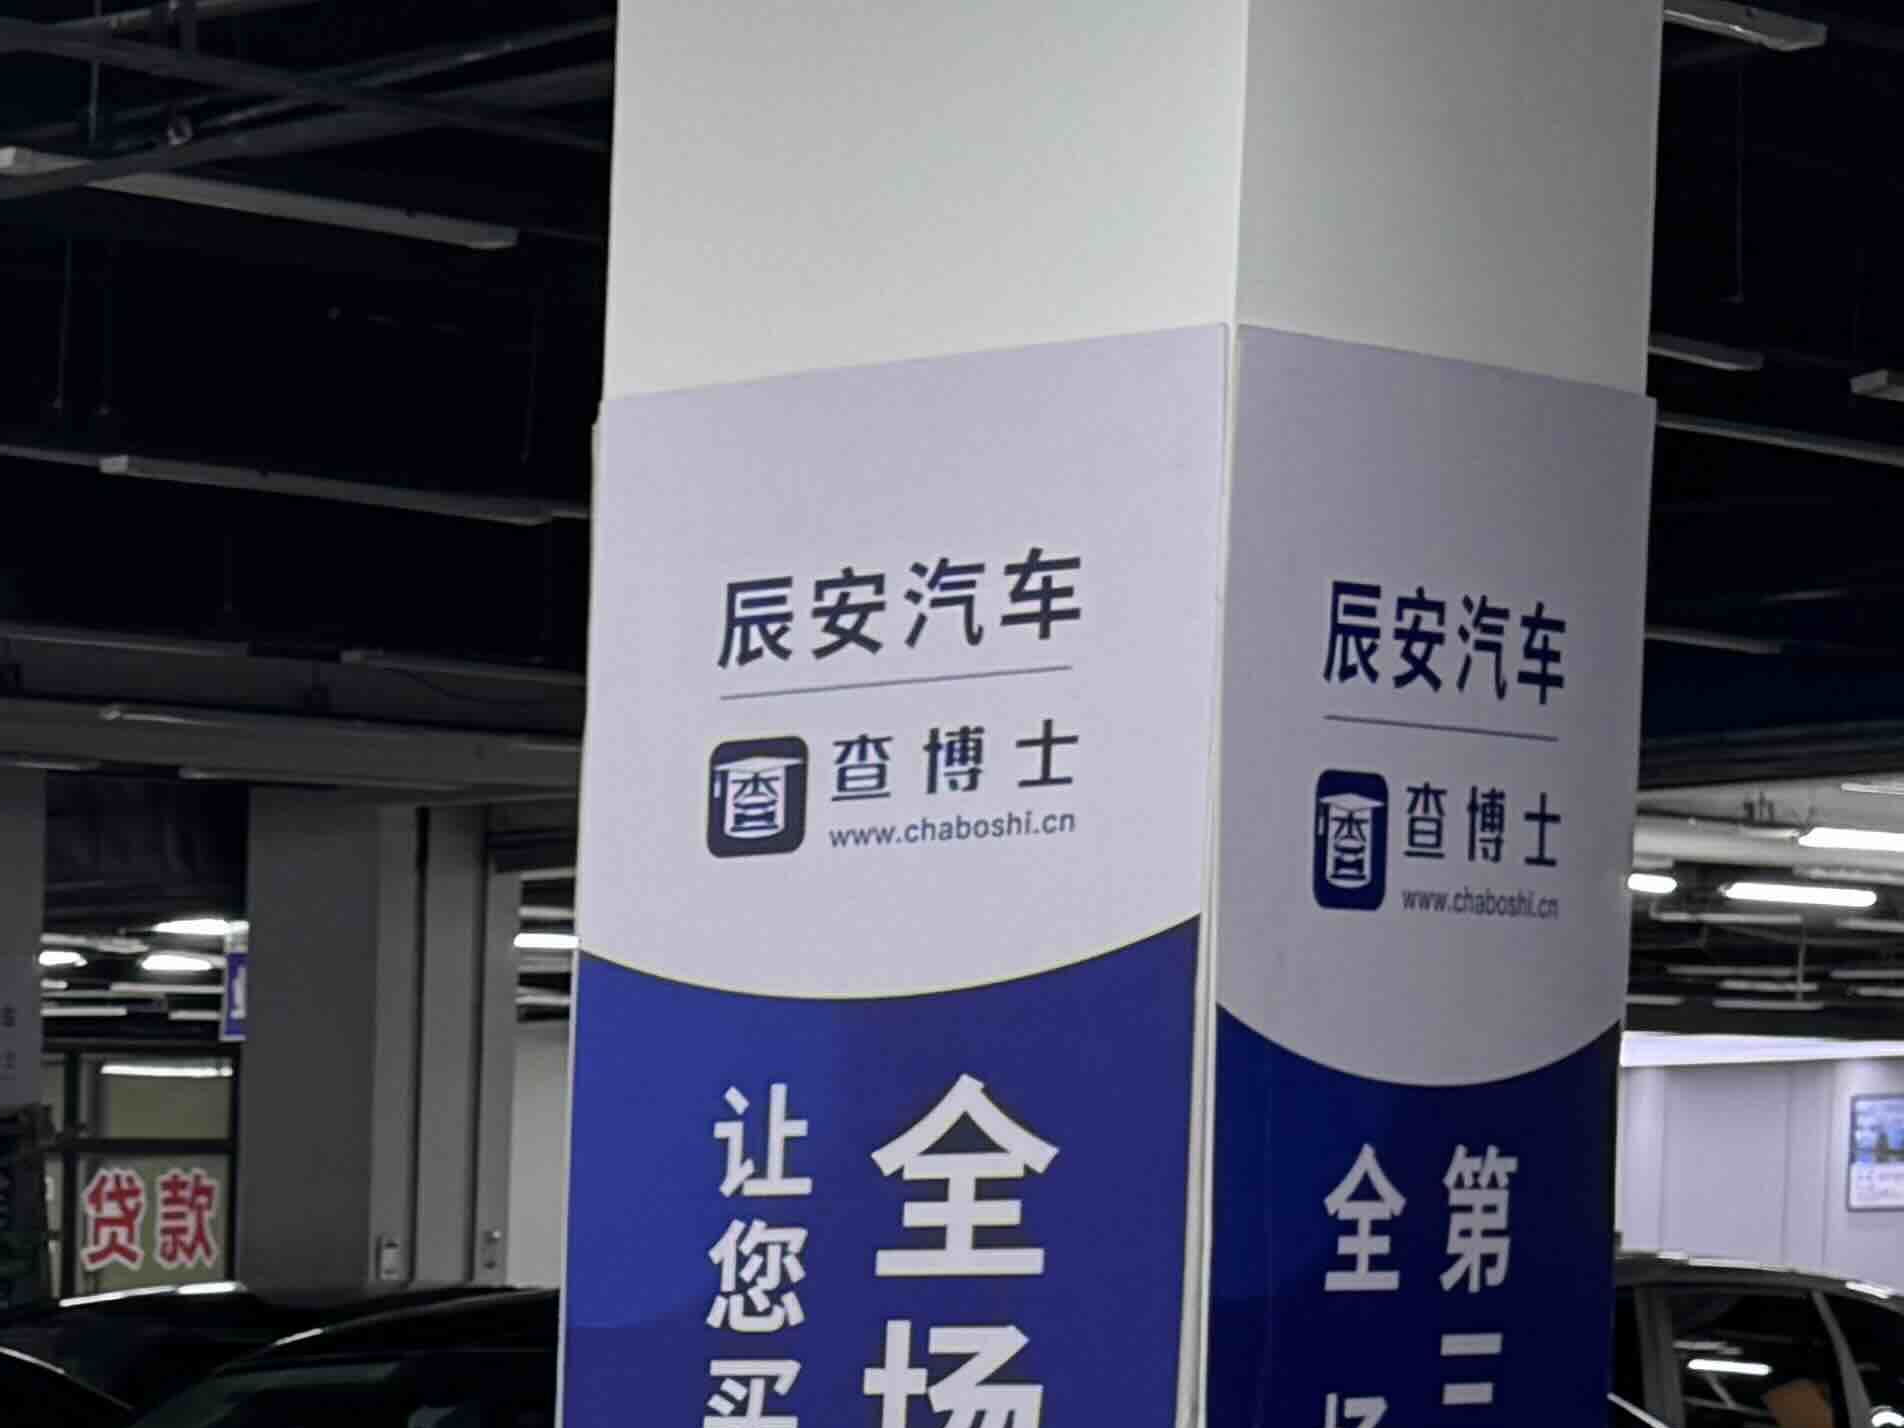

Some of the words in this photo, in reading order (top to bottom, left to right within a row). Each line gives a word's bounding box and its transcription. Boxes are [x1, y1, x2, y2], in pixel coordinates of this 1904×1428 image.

[718, 547, 1080, 668] 辰安汽车
[1323, 580, 1567, 705] 辰安汽车
[831, 718, 1079, 802] 查博士
[829, 811, 1075, 847] www.chaboshi.cn
[1403, 781, 1563, 868] 查博士
[1401, 887, 1560, 919] www.chaboshi.cn
[82, 1168, 219, 1271] 贷款
